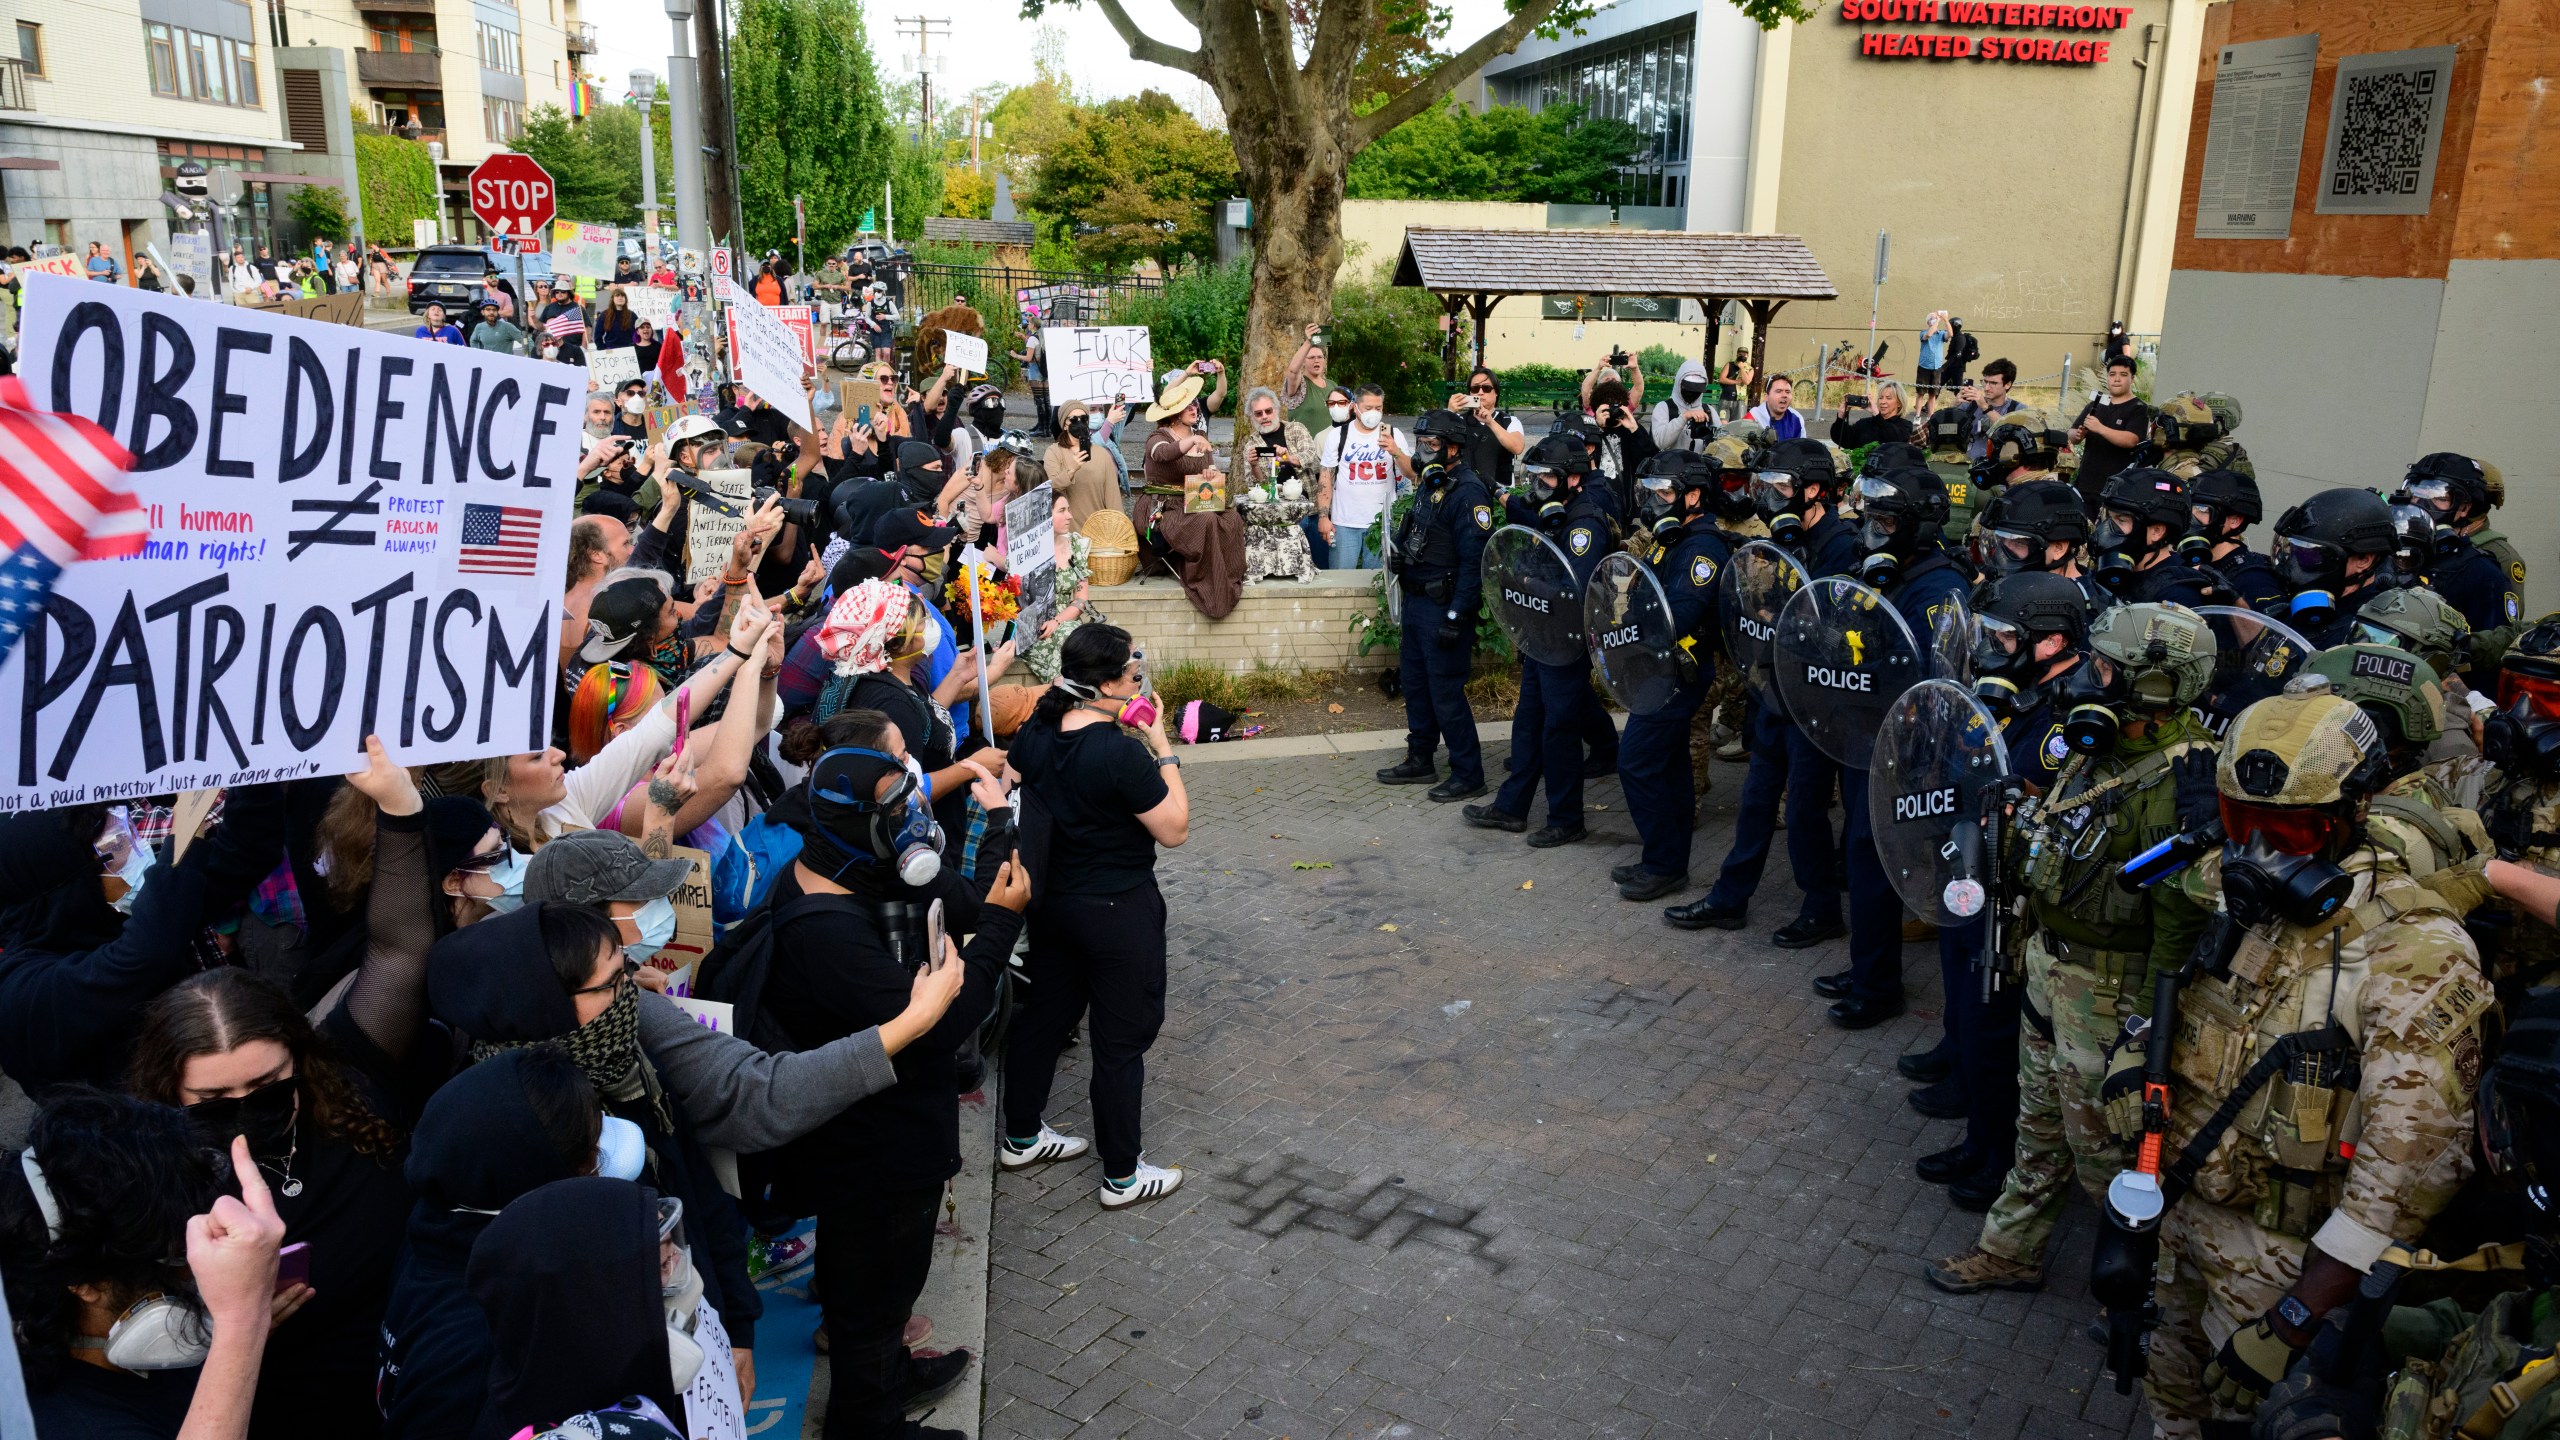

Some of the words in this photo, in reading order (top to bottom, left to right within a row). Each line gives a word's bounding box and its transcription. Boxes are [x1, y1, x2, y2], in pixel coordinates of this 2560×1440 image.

[1842, 0, 1938, 22] SOUTH
[1949, 0, 2133, 29] WATERFRONT
[1862, 33, 1971, 58] HEATED
[1981, 36, 2110, 63] STORAGE
[2269, 71, 2282, 79] Property
[477, 179, 548, 211] STOP
[556, 222, 574, 231] PDX
[2227, 213, 2257, 222] WARNING
[583, 225, 601, 236] SHINE
[583, 235, 612, 244] LIGHT
[567, 246, 576, 254] ON
[715, 287, 731, 296] BLOCK
[717, 278, 728, 287] THIS
[1974, 305, 2023, 319] MISSED
[1073, 328, 1151, 373] FUCK
[594, 356, 619, 369] STOP
[622, 355, 638, 366] THE
[51, 301, 571, 488] OBEDIENCE
[1070, 368, 1146, 402] ICE!
[647, 403, 698, 431] ABOLISH
[1344, 442, 1385, 462] Fuck
[1349, 461, 1388, 481] ICE
[720, 480, 744, 495] STATE
[1945, 484, 1967, 496] LICE
[389, 497, 445, 515] PROTEST
[180, 503, 253, 533] human
[386, 519, 438, 535] FASCISM
[385, 539, 437, 553] ALWAYS!
[691, 537, 702, 549] AS
[706, 535, 733, 547] TERROR
[1009, 537, 1025, 553] WILL
[1026, 530, 1039, 545] YOUR
[199, 538, 266, 569] rights!
[704, 552, 714, 563] IS
[717, 553, 724, 562] A
[1016, 552, 1024, 566] BE
[691, 566, 716, 580] FASCIST
[1698, 558, 1716, 570] POLICE
[1505, 588, 1549, 614] POLICE
[1602, 625, 1639, 649] POLICE
[1739, 616, 1775, 641] POLIC
[2355, 653, 2412, 681] POLICE
[18, 571, 550, 787] PATRIOTISM
[1807, 666, 1871, 692] POLICE
[31, 793, 45, 808] a
[50, 784, 85, 807] paid
[93, 774, 164, 799] protestor!
[167, 773, 197, 791] Just
[202, 773, 222, 787] an
[229, 767, 270, 785] angry
[274, 759, 307, 781] girl!
[1896, 788, 1955, 820] POLICE
[2444, 983, 2475, 1014] 316
[711, 1355, 724, 1382] the
[699, 1376, 741, 1440] EPSTEIN
